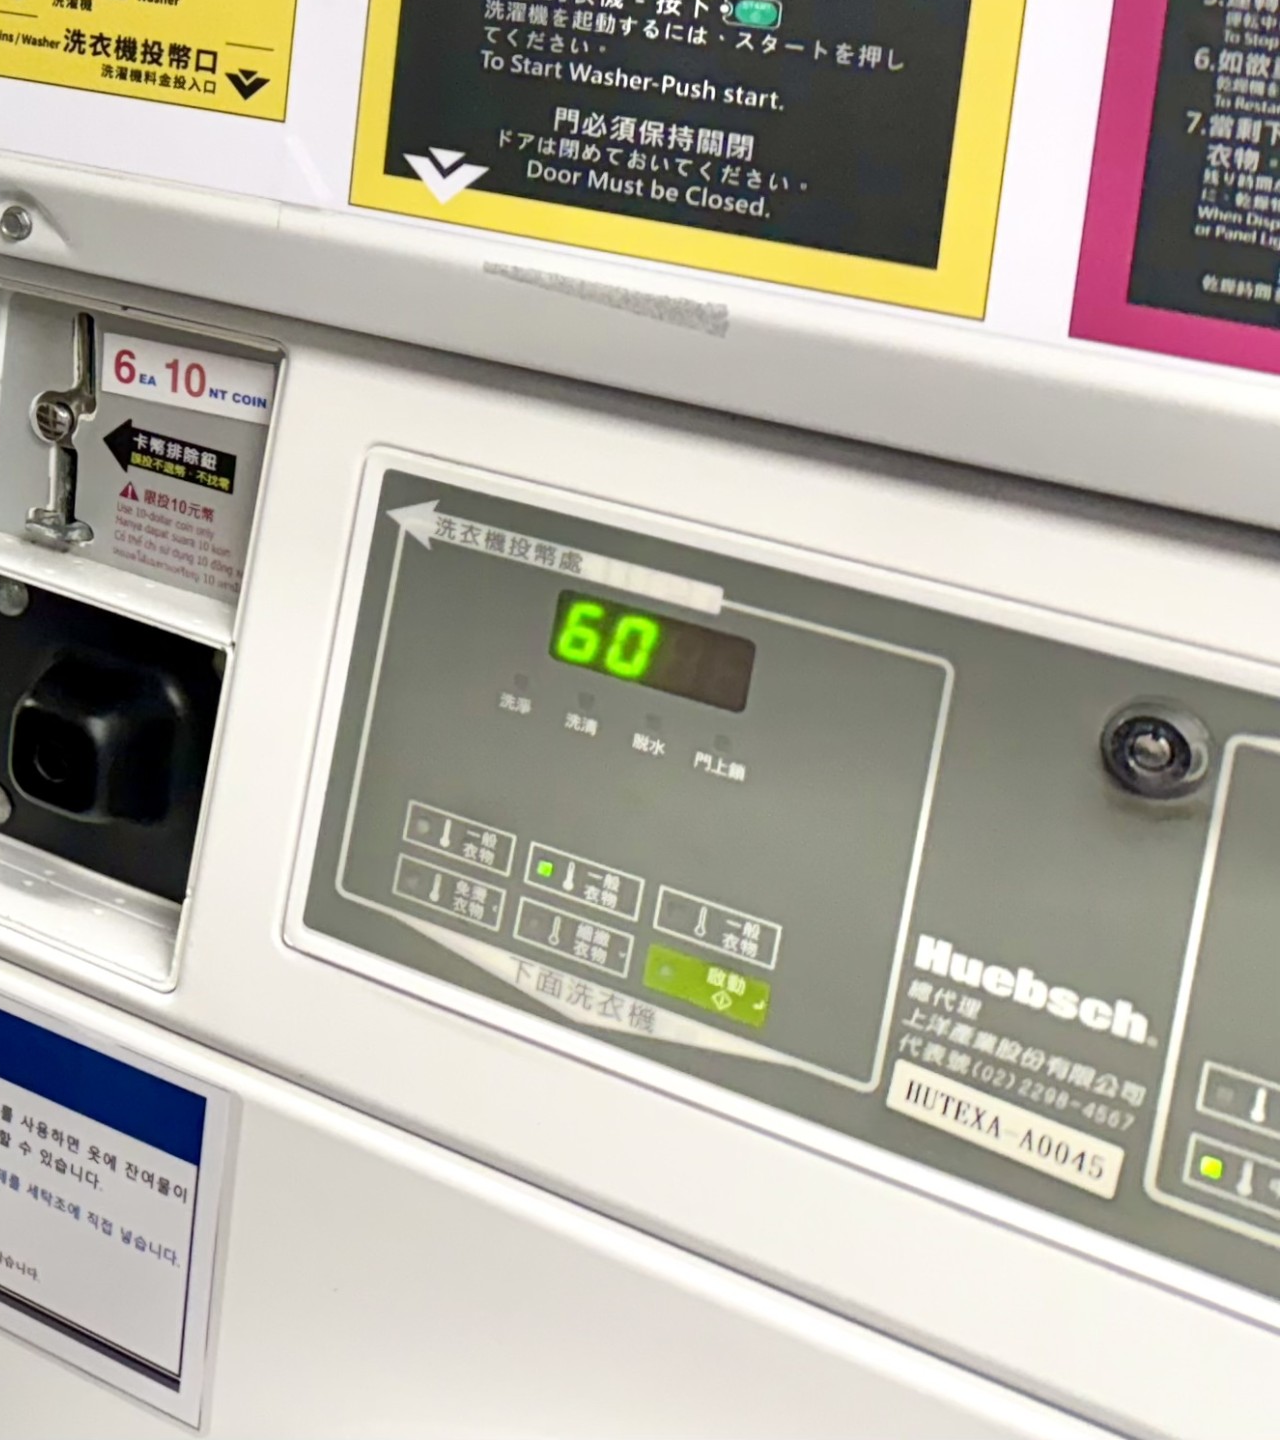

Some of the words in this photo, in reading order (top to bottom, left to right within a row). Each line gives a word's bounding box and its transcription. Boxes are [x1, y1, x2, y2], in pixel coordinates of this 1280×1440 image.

[22, 33, 61, 50] Washer
[63, 28, 218, 74] 洗衣機投幣口
[480, 49, 505, 71] To
[510, 53, 563, 81] Start
[569, 62, 717, 102] Washer-Push
[723, 84, 784, 111] start.
[553, 106, 755, 162] 門必須保持關閉
[526, 160, 583, 187] Door
[588, 169, 644, 196] Must
[650, 177, 679, 202] be
[685, 186, 771, 220] Closed.
[114, 349, 136, 384] 6
[139, 374, 157, 386] EA
[165, 358, 206, 398] 10
[209, 388, 228, 401] NT
[232, 393, 267, 409] COIN
[435, 516, 584, 575] 洗衣機投幣處
[556, 600, 661, 679] 60
[511, 956, 658, 1035] 下面洗衣機
[914, 933, 1148, 1045] Huebsch
[905, 1080, 1104, 1182] HUTEXA-A0045
